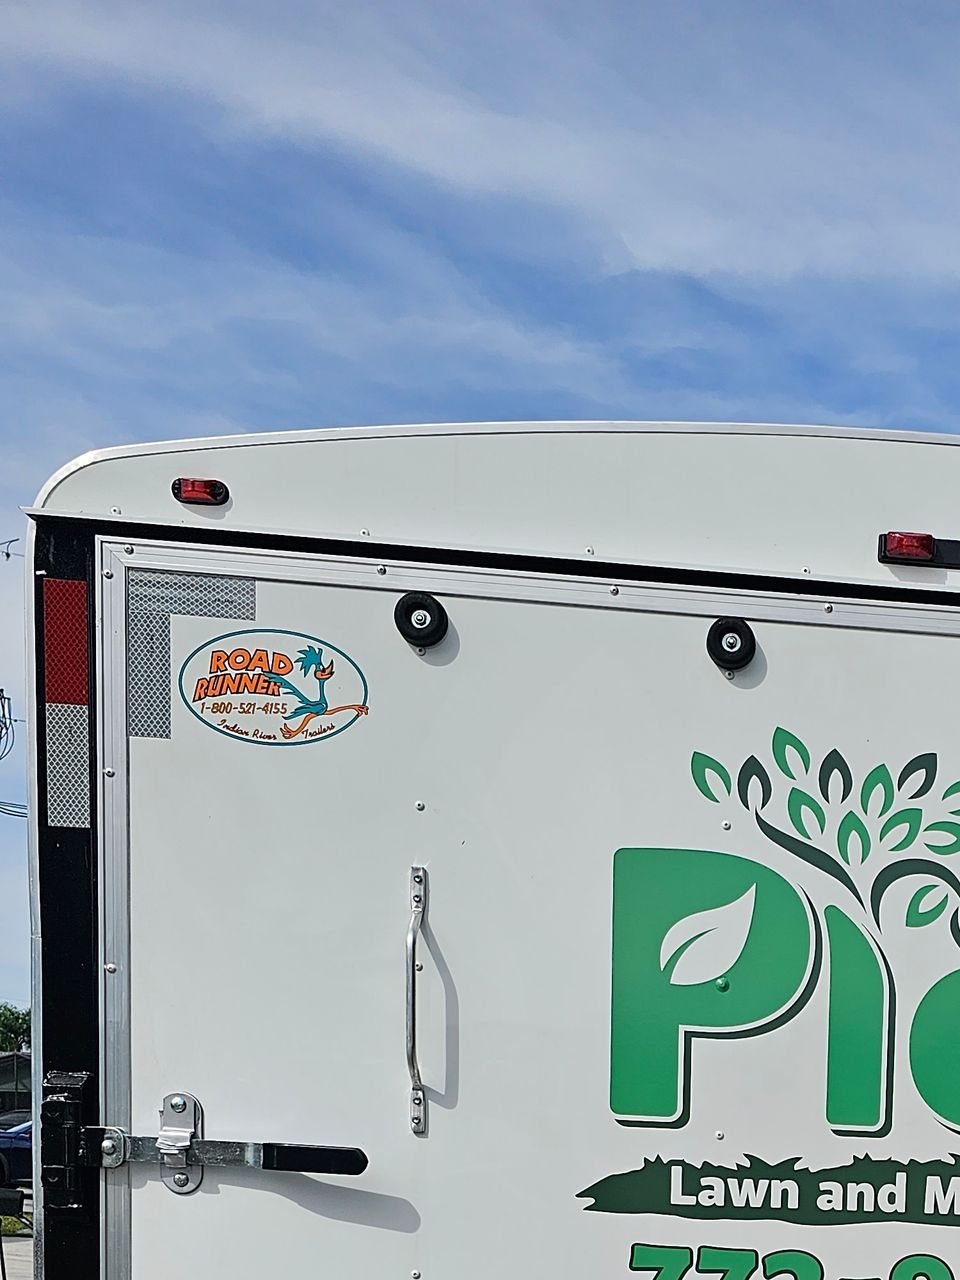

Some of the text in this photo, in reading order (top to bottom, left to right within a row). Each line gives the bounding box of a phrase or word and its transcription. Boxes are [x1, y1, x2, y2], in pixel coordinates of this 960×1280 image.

[209, 648, 294, 676] ROAD
[200, 701, 288, 714] 1-800-521-4155
[217, 719, 250, 736] Indian
[302, 723, 336, 739] Trailers
[670, 1166, 799, 1209] Lawn
[816, 1172, 907, 1213] and
